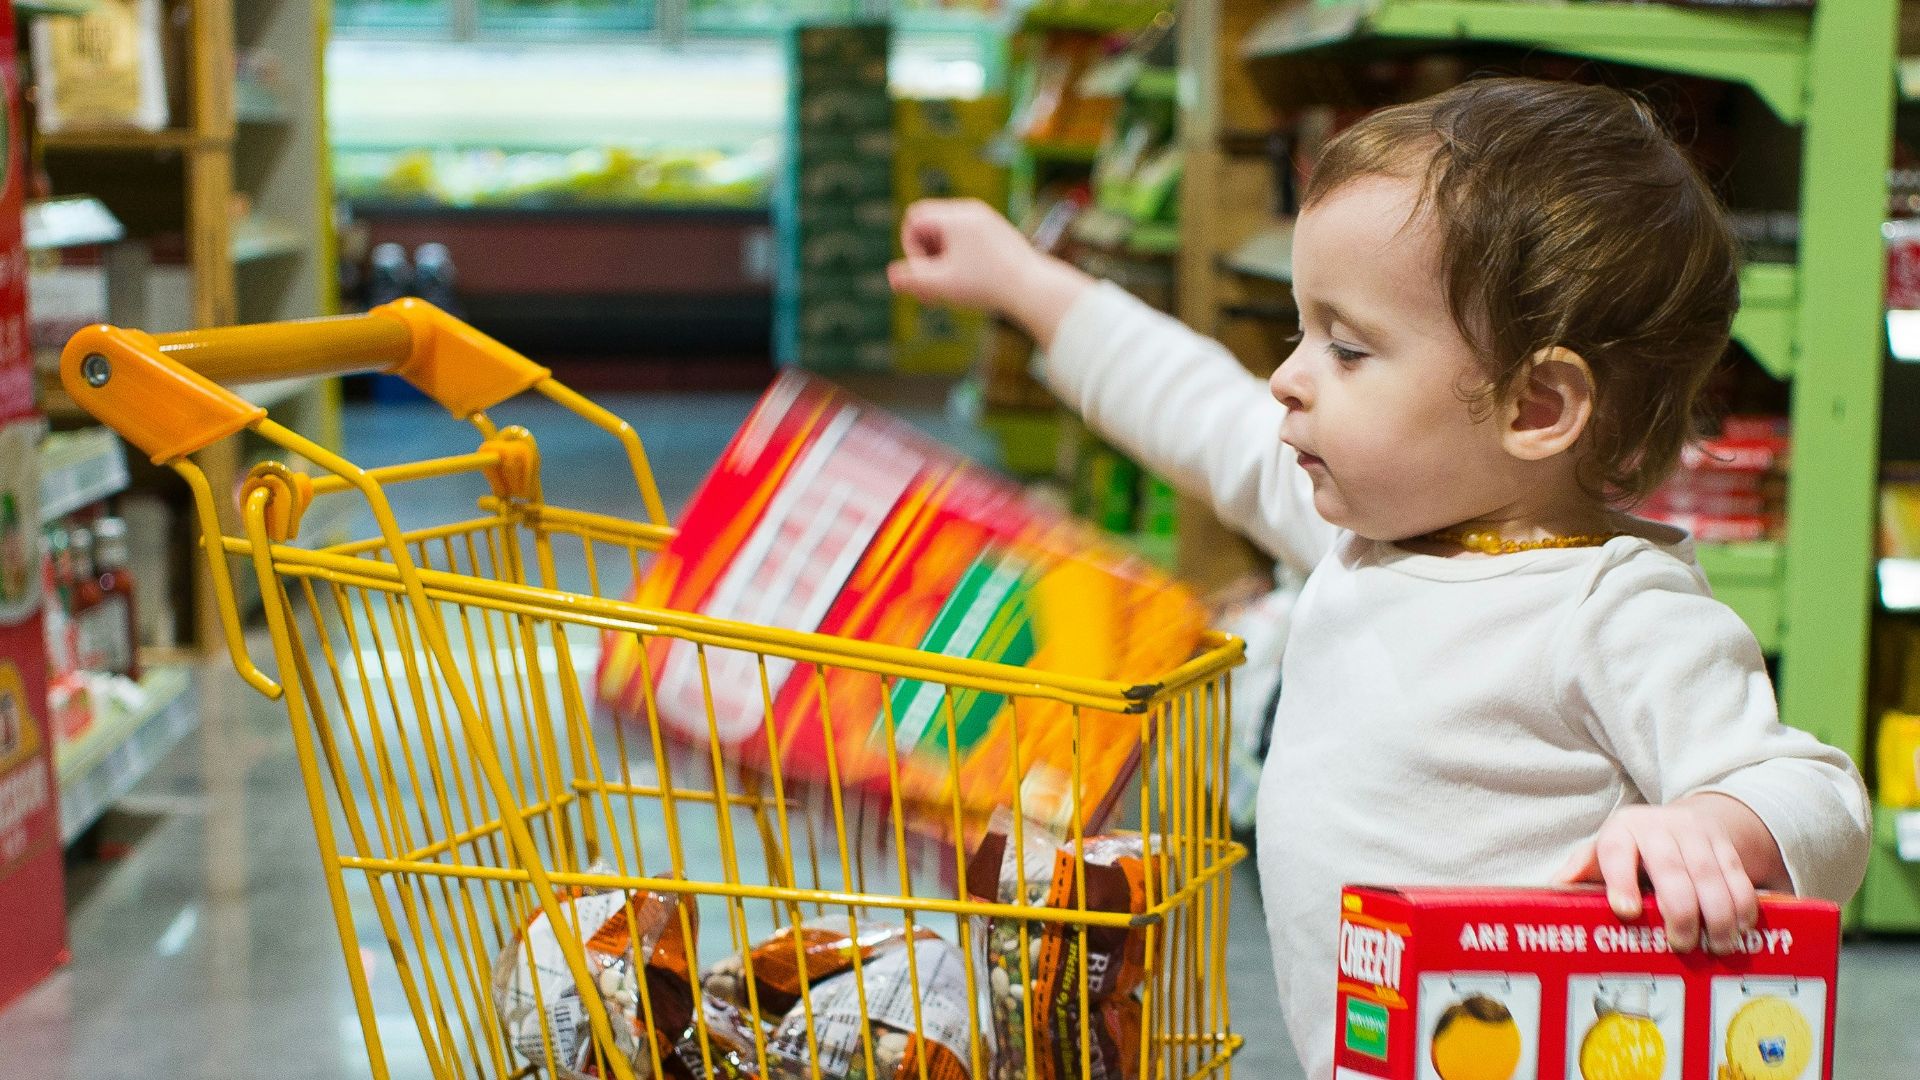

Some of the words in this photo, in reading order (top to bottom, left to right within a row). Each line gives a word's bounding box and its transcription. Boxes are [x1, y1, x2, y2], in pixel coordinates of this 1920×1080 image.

[1459, 923, 1508, 952] ARE
[1514, 924, 1587, 953] THESE
[1593, 925, 1674, 953] CHEES
